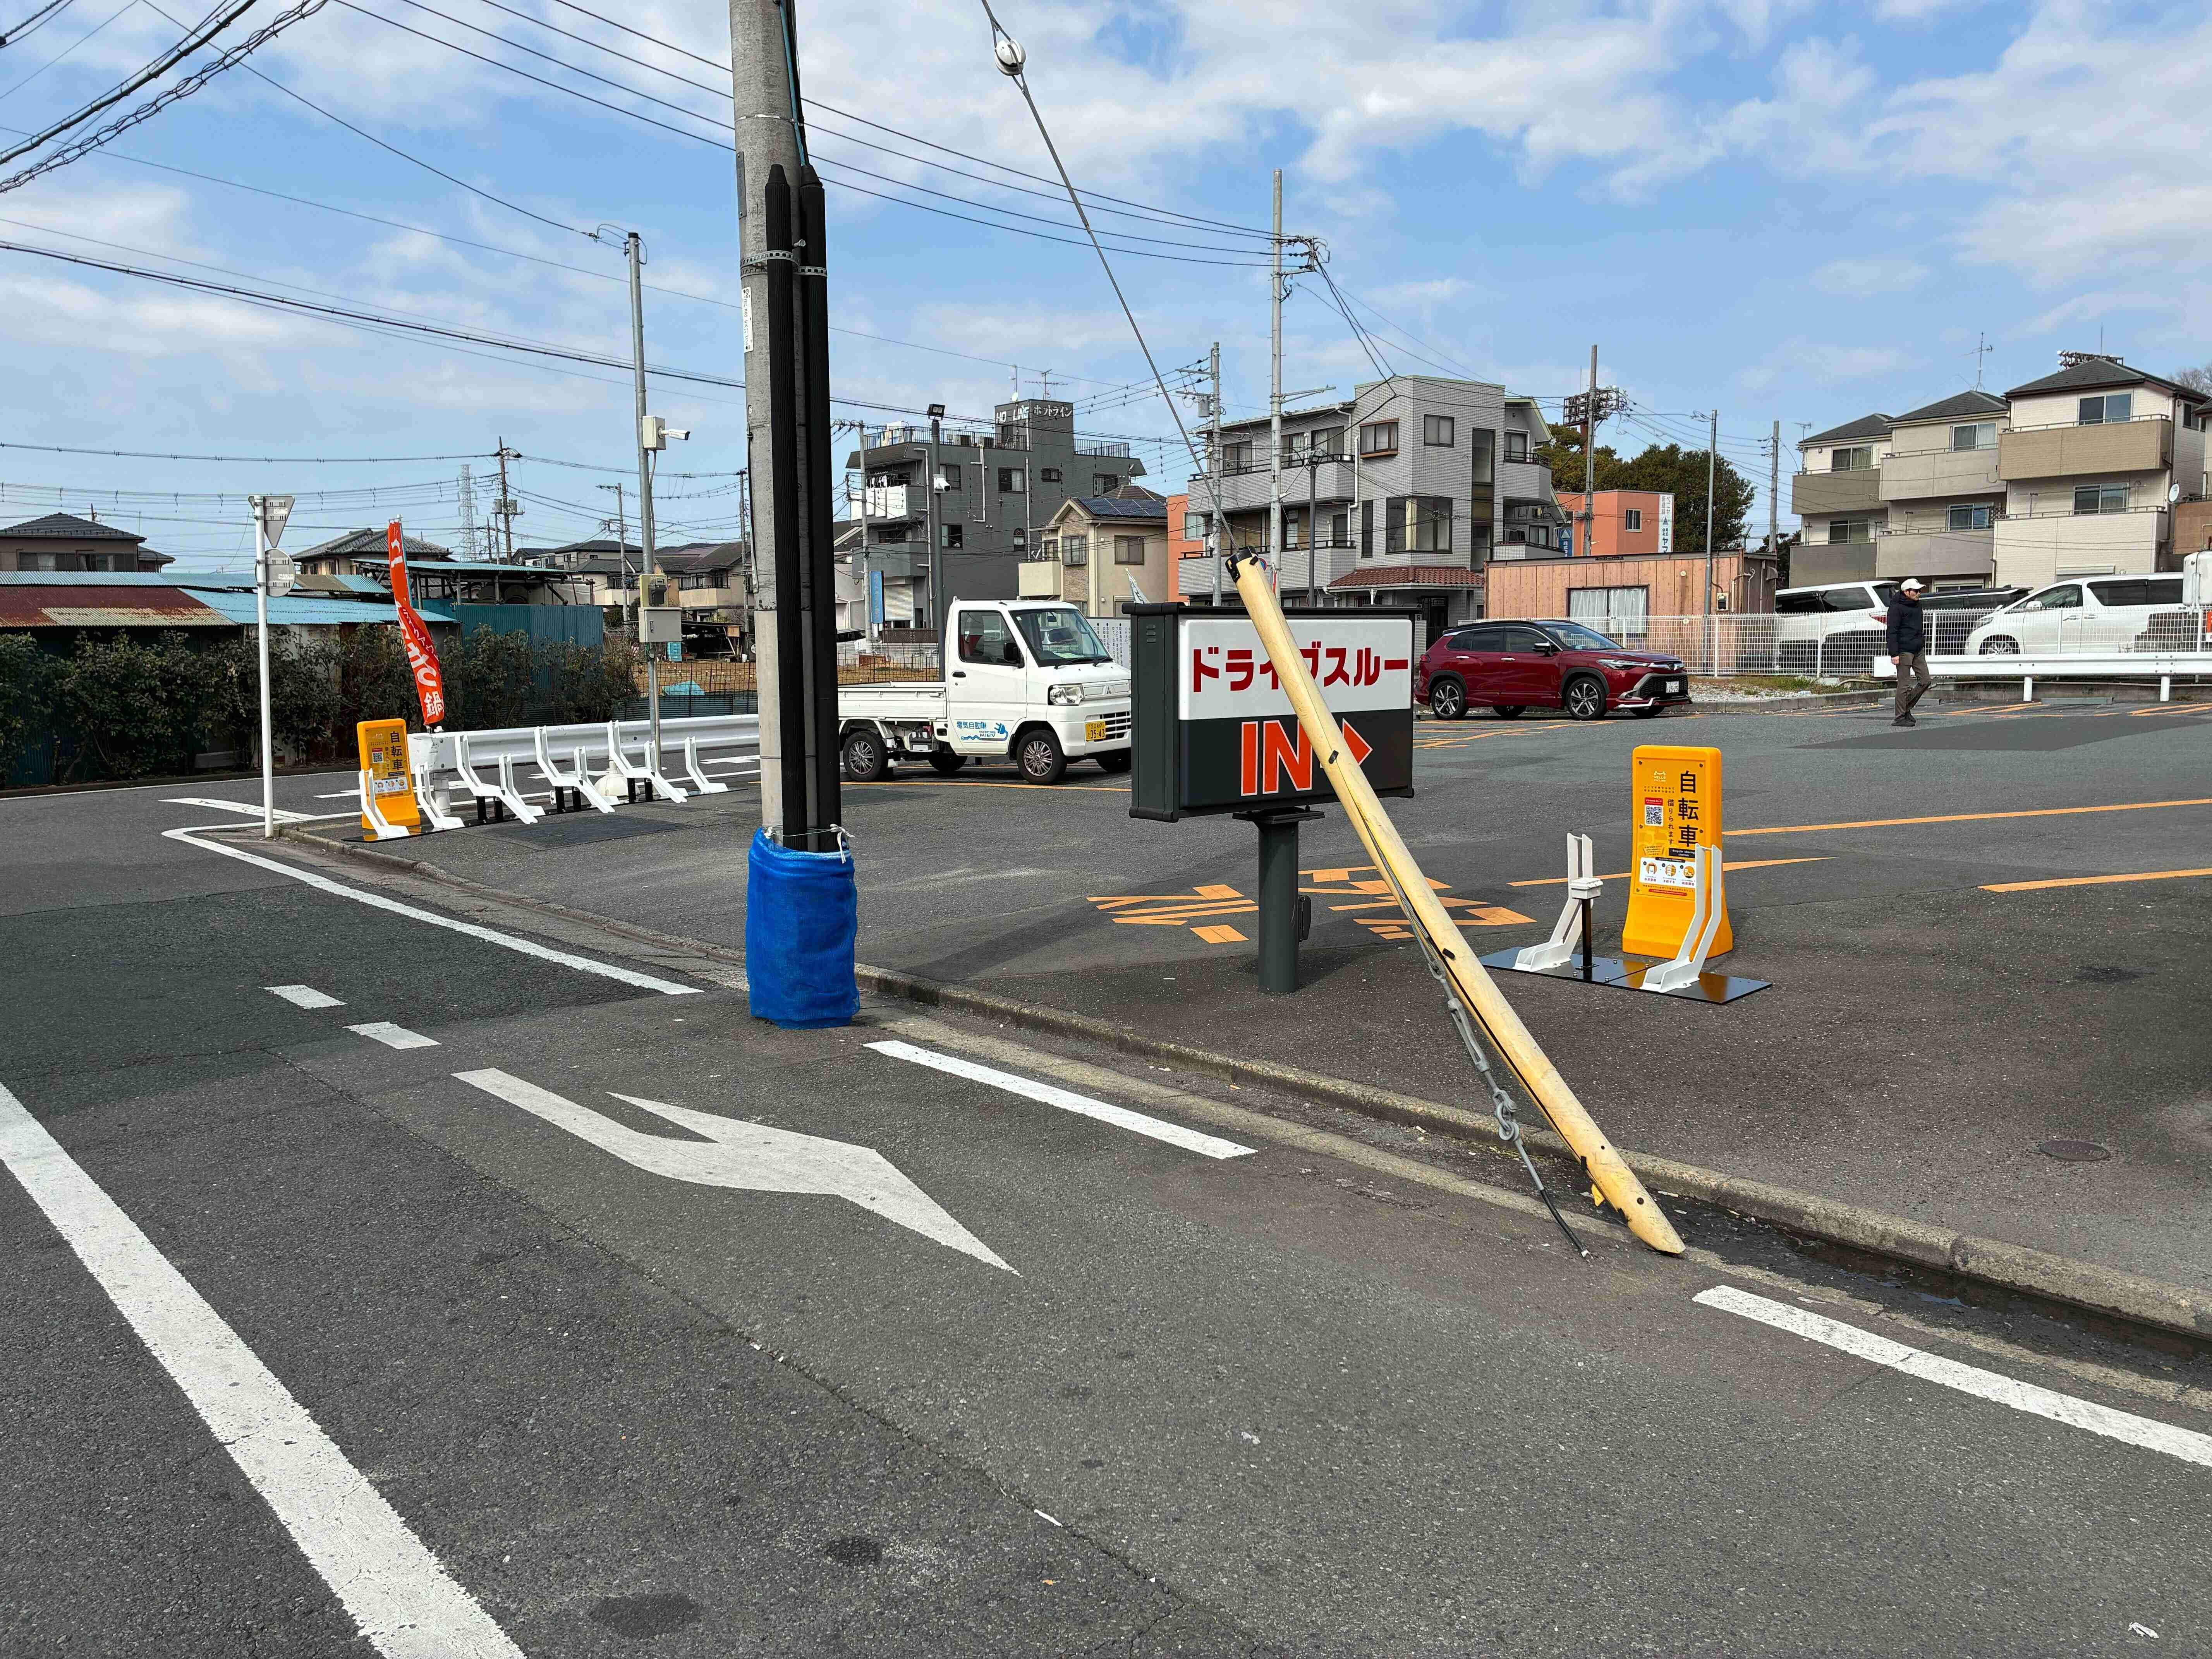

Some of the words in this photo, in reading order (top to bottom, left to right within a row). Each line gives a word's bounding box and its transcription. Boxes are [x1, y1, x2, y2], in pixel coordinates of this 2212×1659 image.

[1034, 404, 1072, 417] ホットライン
[1193, 641, 1408, 693] ドライブスルー
[957, 721, 987, 729] 電気自動車
[1090, 728, 1105, 739] 35-43
[390, 731, 404, 770] 自転車
[1240, 720, 1313, 797] IN
[1678, 770, 1699, 847] 自転車
